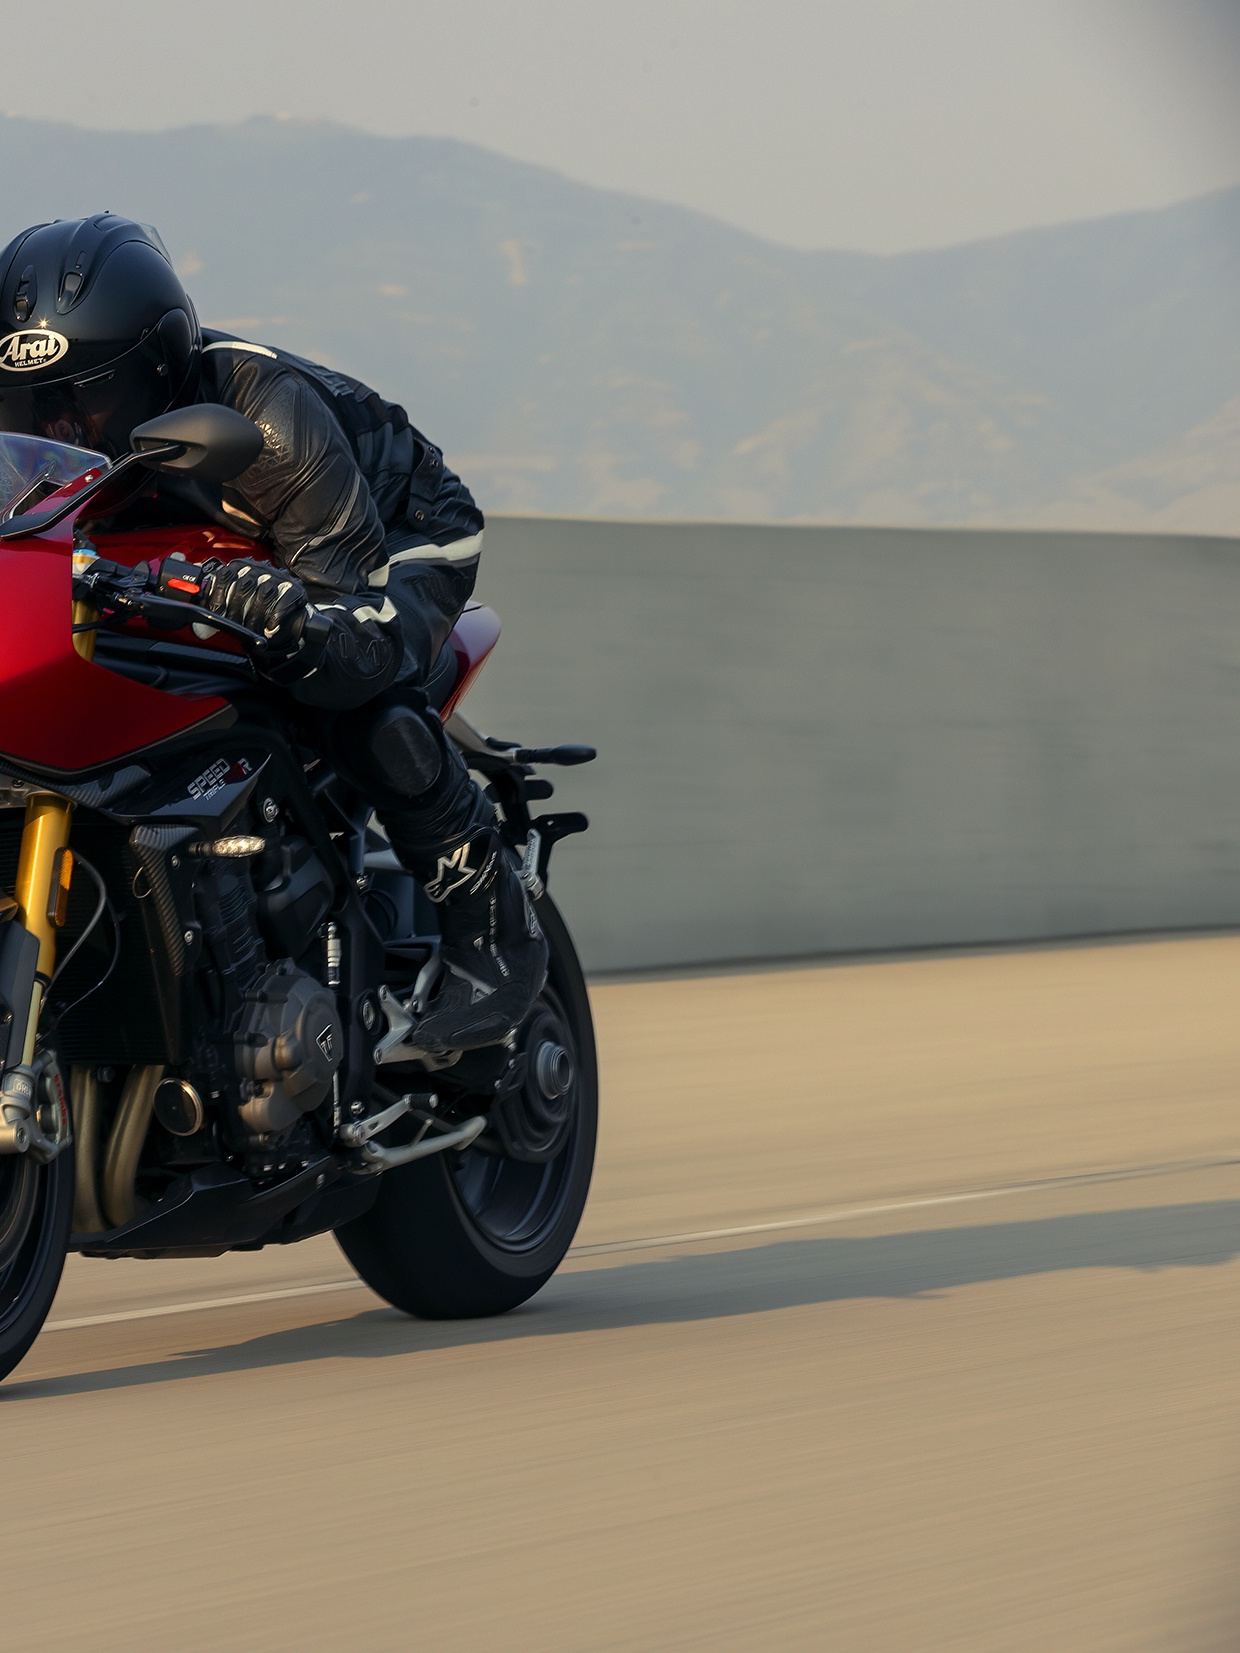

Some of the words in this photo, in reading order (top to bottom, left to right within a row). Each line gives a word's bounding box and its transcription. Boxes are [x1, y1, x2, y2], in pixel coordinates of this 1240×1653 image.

[0, 333, 59, 363] Arai
[14, 357, 44, 368] HELMET
[187, 758, 231, 800] SPEED
